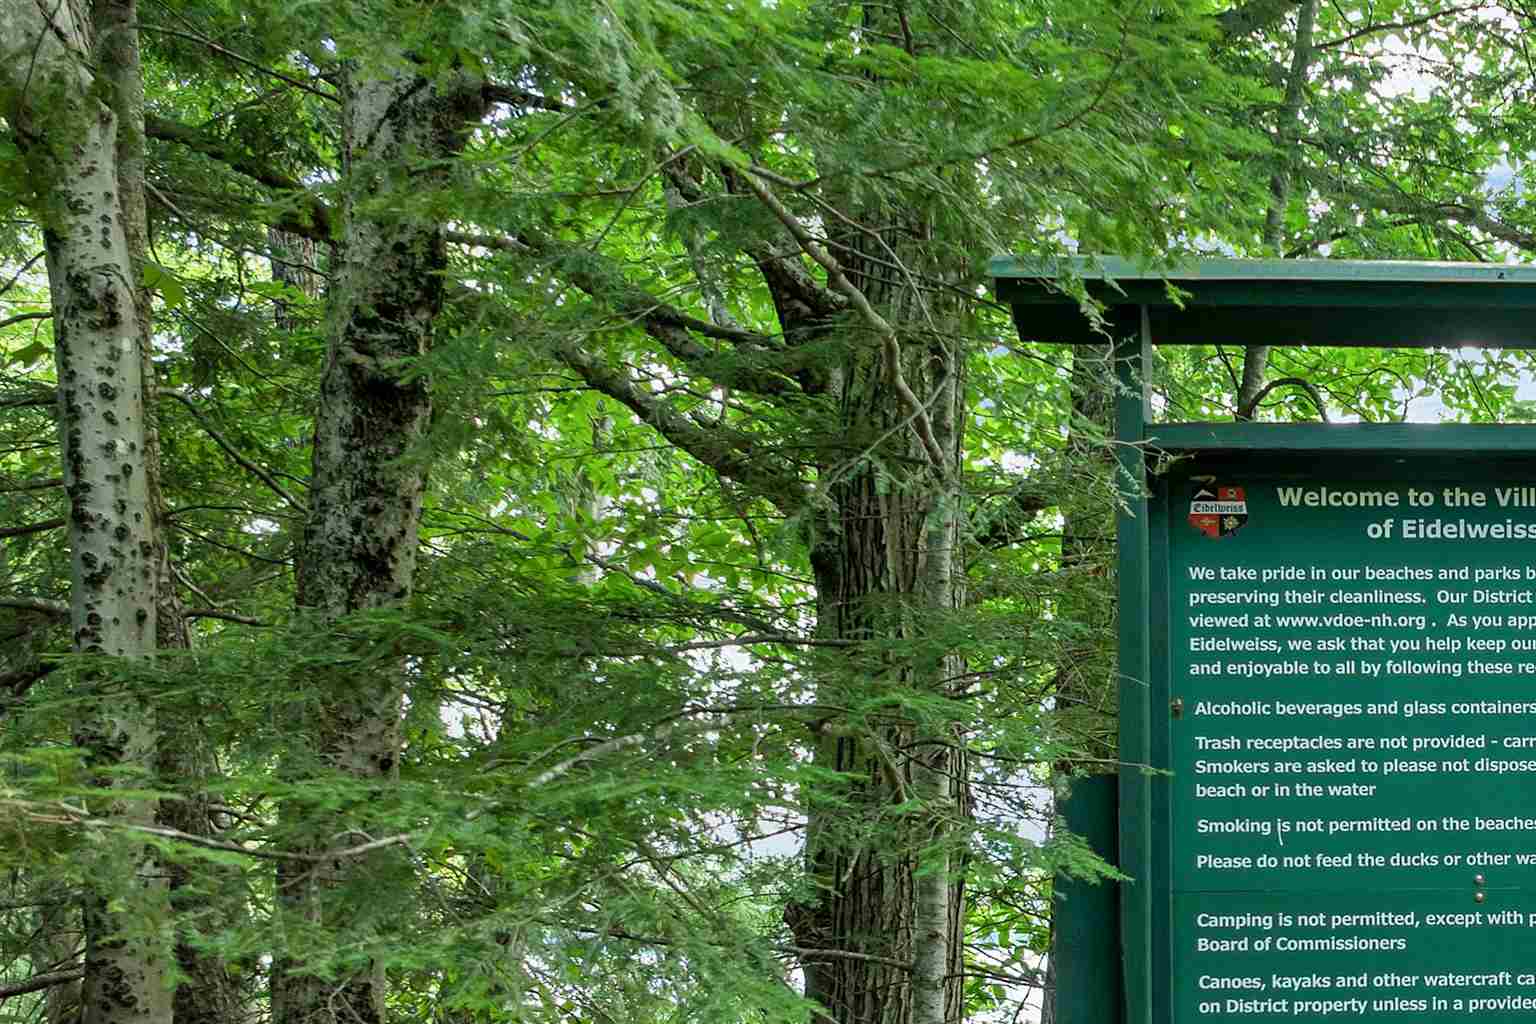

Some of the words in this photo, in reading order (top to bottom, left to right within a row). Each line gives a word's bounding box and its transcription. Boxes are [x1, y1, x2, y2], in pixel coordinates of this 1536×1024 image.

[1276, 486, 1399, 507] Welcome
[1407, 487, 1434, 507] to
[1442, 486, 1486, 507] the
[1366, 517, 1394, 539] of
[1188, 565, 1215, 580] We
[1219, 565, 1257, 580] take
[1261, 564, 1306, 583] pride
[1310, 565, 1326, 580] in
[1330, 567, 1361, 580] our
[1364, 564, 1433, 580] beaches
[1437, 565, 1469, 580] and
[1474, 565, 1521, 583] parks
[1188, 612, 1248, 628] viewed
[1253, 613, 1271, 628] at
[1275, 612, 1425, 630] www.vdoe-nh.org
[1446, 612, 1467, 627] As
[1471, 615, 1502, 630] you
[1189, 659, 1221, 675] and
[1226, 659, 1309, 678] enjoyable
[1312, 660, 1331, 674] to
[1334, 659, 1355, 674] all
[1360, 659, 1381, 677] by
[1385, 659, 1462, 677] following
[1466, 659, 1513, 674] these
[1193, 700, 1271, 716] Alcoholic
[1275, 700, 1362, 718] beverages
[1366, 699, 1398, 715] and
[1402, 699, 1446, 717] glass
[1194, 734, 1241, 750] Trash
[1246, 734, 1343, 753] receptacles
[1346, 736, 1375, 749] are
[1379, 734, 1408, 749] not
[1412, 733, 1485, 752] provided
[1195, 782, 1246, 798] beach
[1250, 785, 1270, 797] or
[1274, 782, 1290, 797] in
[1294, 781, 1323, 796] the
[1327, 782, 1377, 796] water
[1196, 817, 1271, 835] Smoking
[1276, 817, 1291, 832] is
[1295, 818, 1324, 832] not
[1328, 816, 1411, 834] permitted
[1415, 819, 1437, 831] on
[1441, 816, 1470, 831] the
[1196, 853, 1252, 869] Please
[1256, 853, 1278, 868] do
[1282, 853, 1311, 868] not
[1315, 852, 1352, 868] feed
[1356, 852, 1385, 867] the
[1389, 851, 1439, 867] ducks
[1442, 853, 1462, 866] or
[1465, 850, 1511, 866] other
[1197, 936, 1248, 952] Board
[1253, 935, 1272, 951] of
[1275, 934, 1406, 951] Commissioners
[1198, 1001, 1220, 1014] on
[1225, 997, 1288, 1013] District
[1293, 997, 1368, 1015] property
[1372, 996, 1427, 1012] unless
[1431, 995, 1448, 1011] in
[1452, 998, 1463, 1011] a
